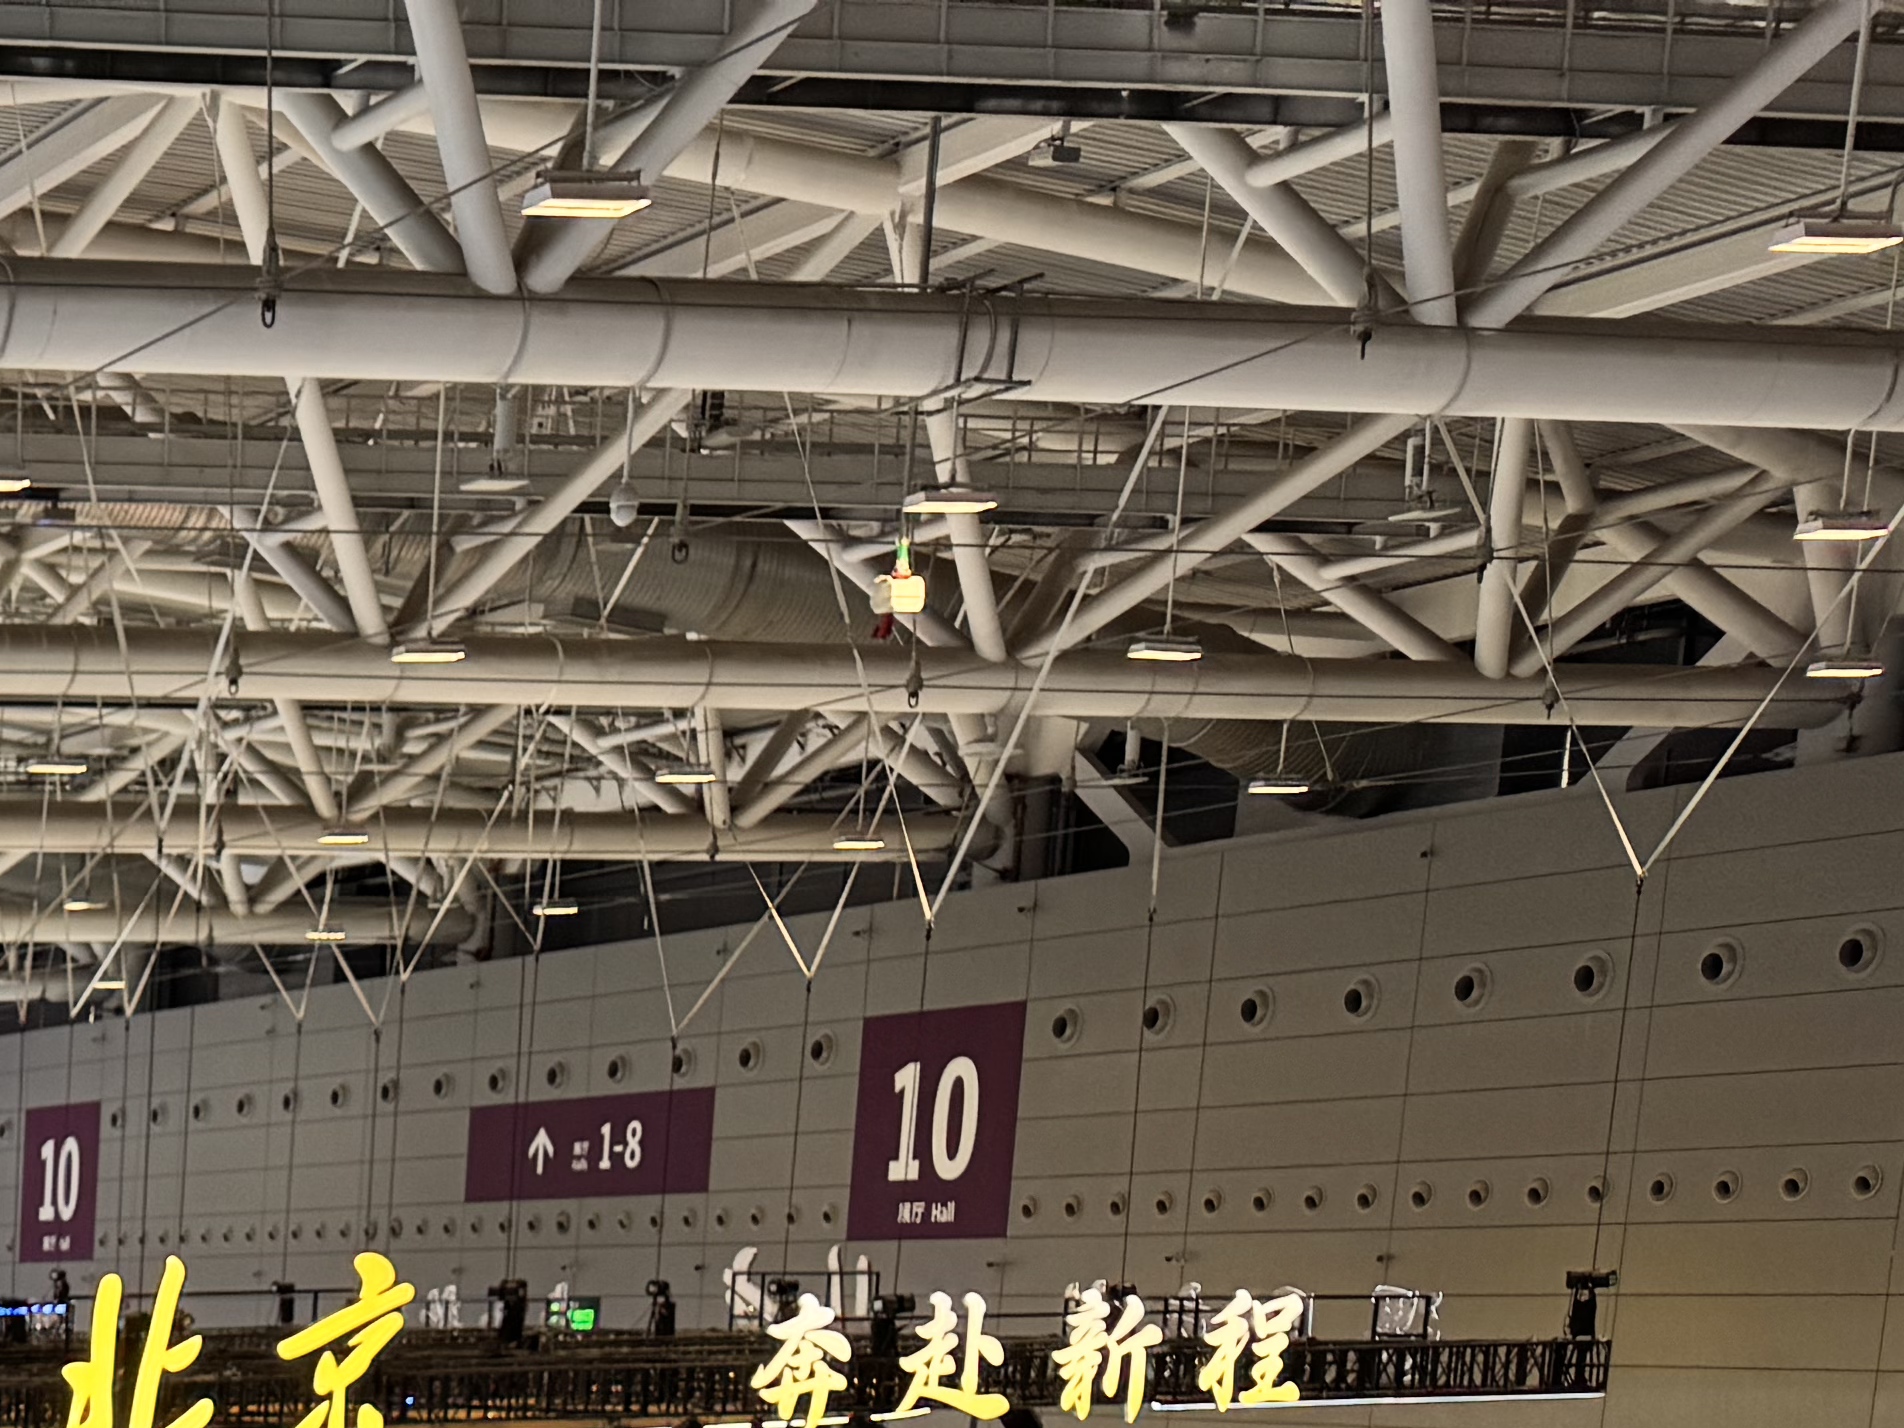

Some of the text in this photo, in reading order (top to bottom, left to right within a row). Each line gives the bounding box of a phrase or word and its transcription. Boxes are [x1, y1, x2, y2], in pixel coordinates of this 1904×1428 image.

[598, 1119, 643, 1171] 1-8
[888, 1055, 980, 1182] 10
[38, 1135, 80, 1223] 10
[931, 1201, 956, 1223] Hall
